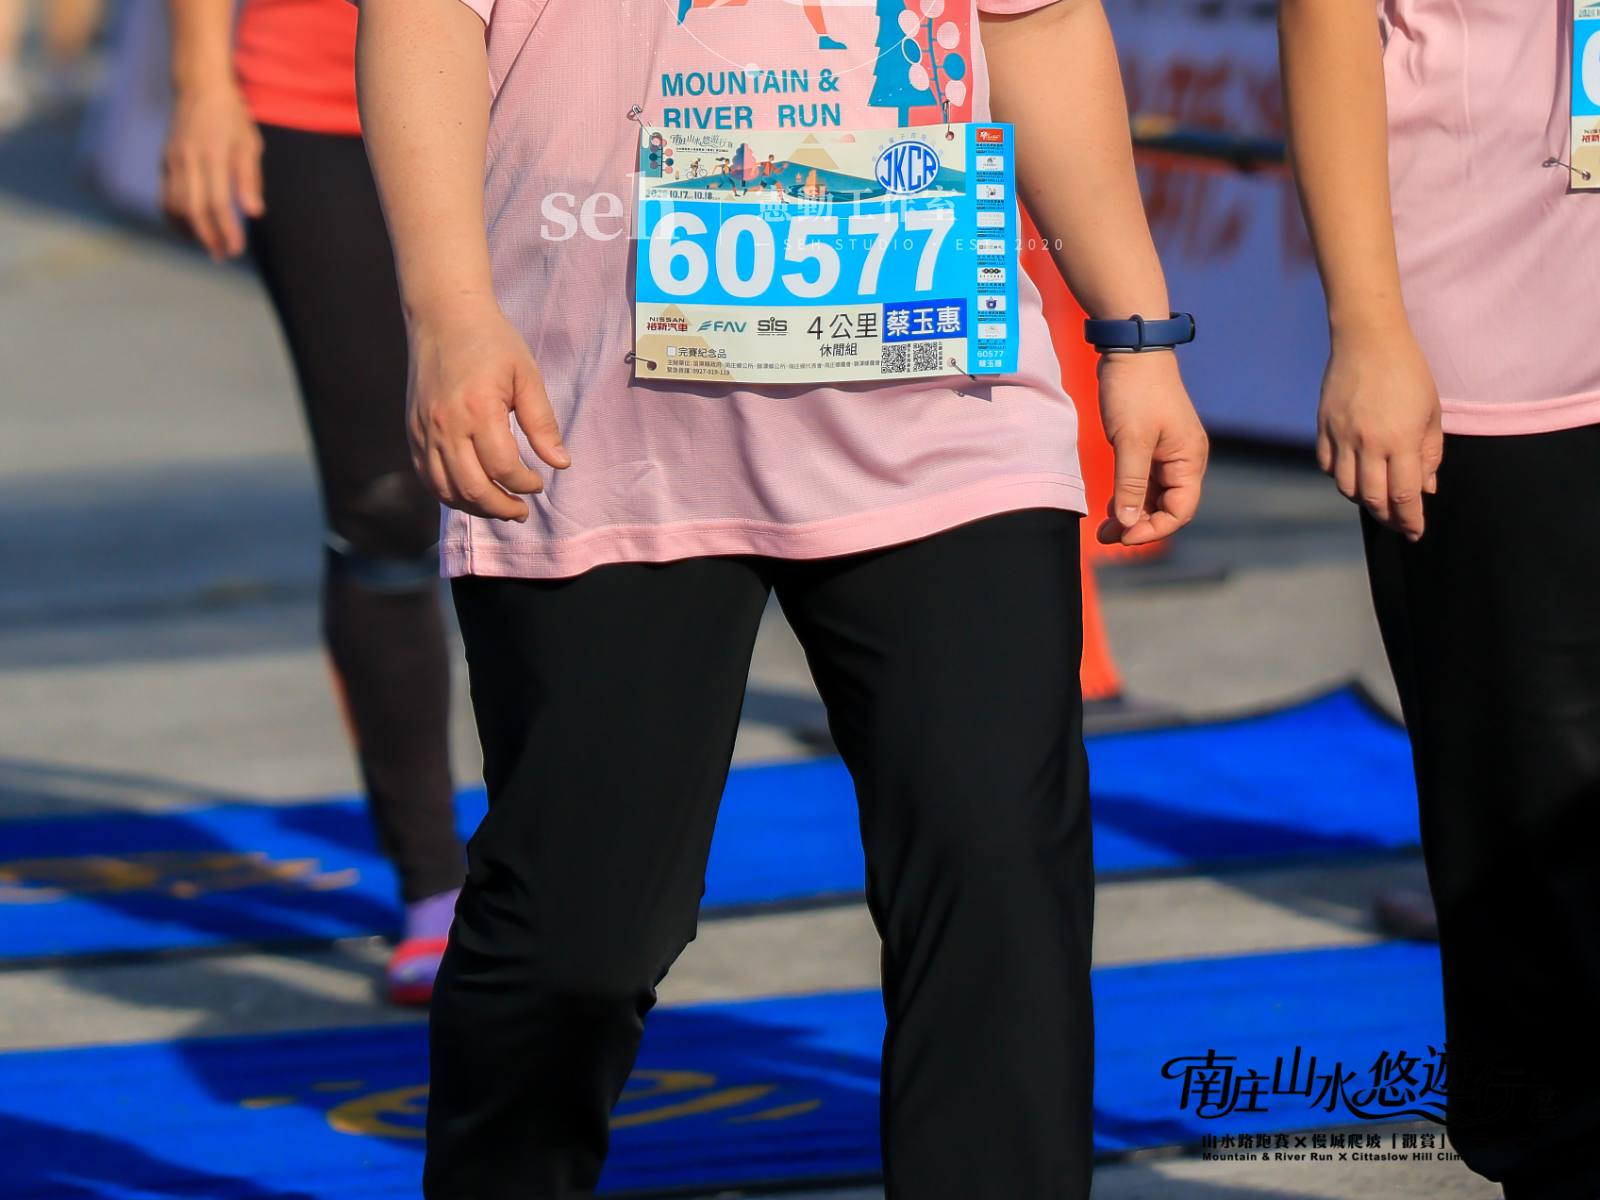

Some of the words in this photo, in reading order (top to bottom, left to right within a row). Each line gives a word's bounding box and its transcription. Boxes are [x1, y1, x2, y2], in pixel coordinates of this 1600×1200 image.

[661, 69, 809, 97] MOUNTAIN
[818, 69, 840, 92] &
[664, 105, 753, 129] RIVER
[779, 103, 842, 127] RUN
[880, 145, 937, 191] JKCR
[649, 208, 956, 298] 60577
[887, 306, 961, 338] 蔡玉惠
